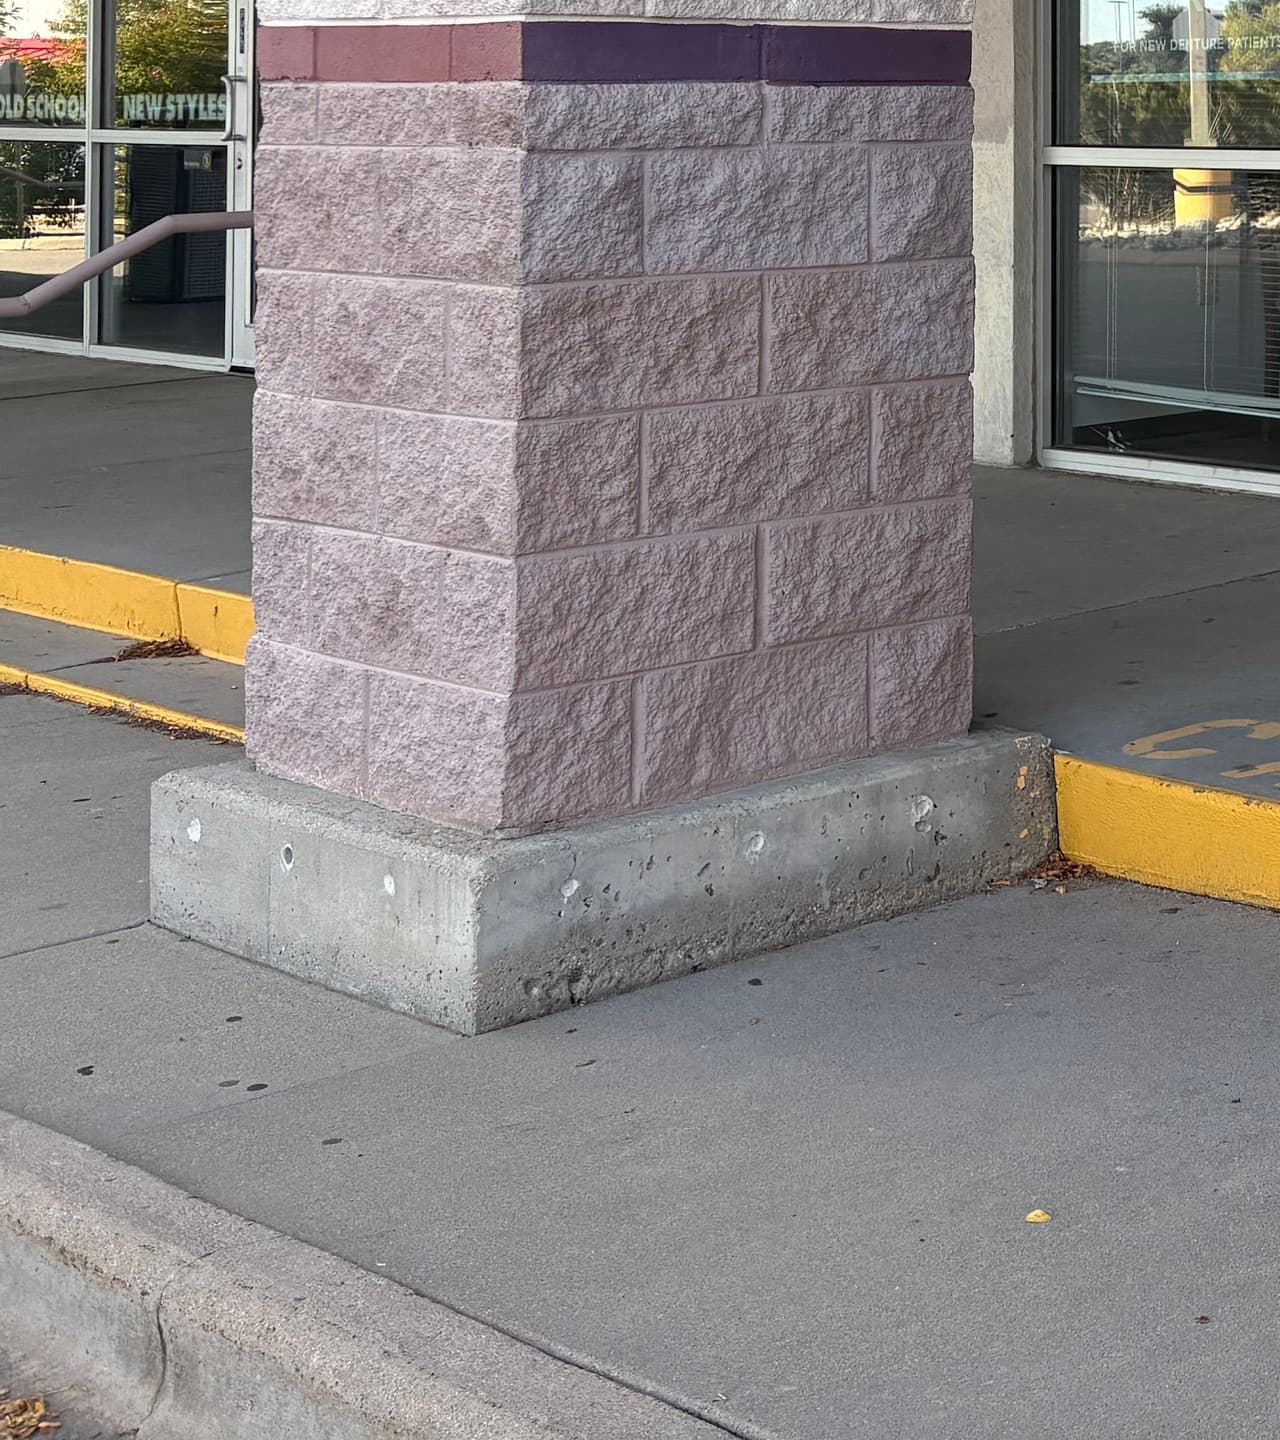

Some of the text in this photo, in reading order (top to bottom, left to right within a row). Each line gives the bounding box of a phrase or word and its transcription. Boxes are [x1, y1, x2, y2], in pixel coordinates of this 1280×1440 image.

[1139, 38, 1167, 52] NEW
[1170, 37, 1225, 52] DENTURE
[26, 92, 86, 121] SCHOOL
[122, 92, 226, 121] NEW STYLES
